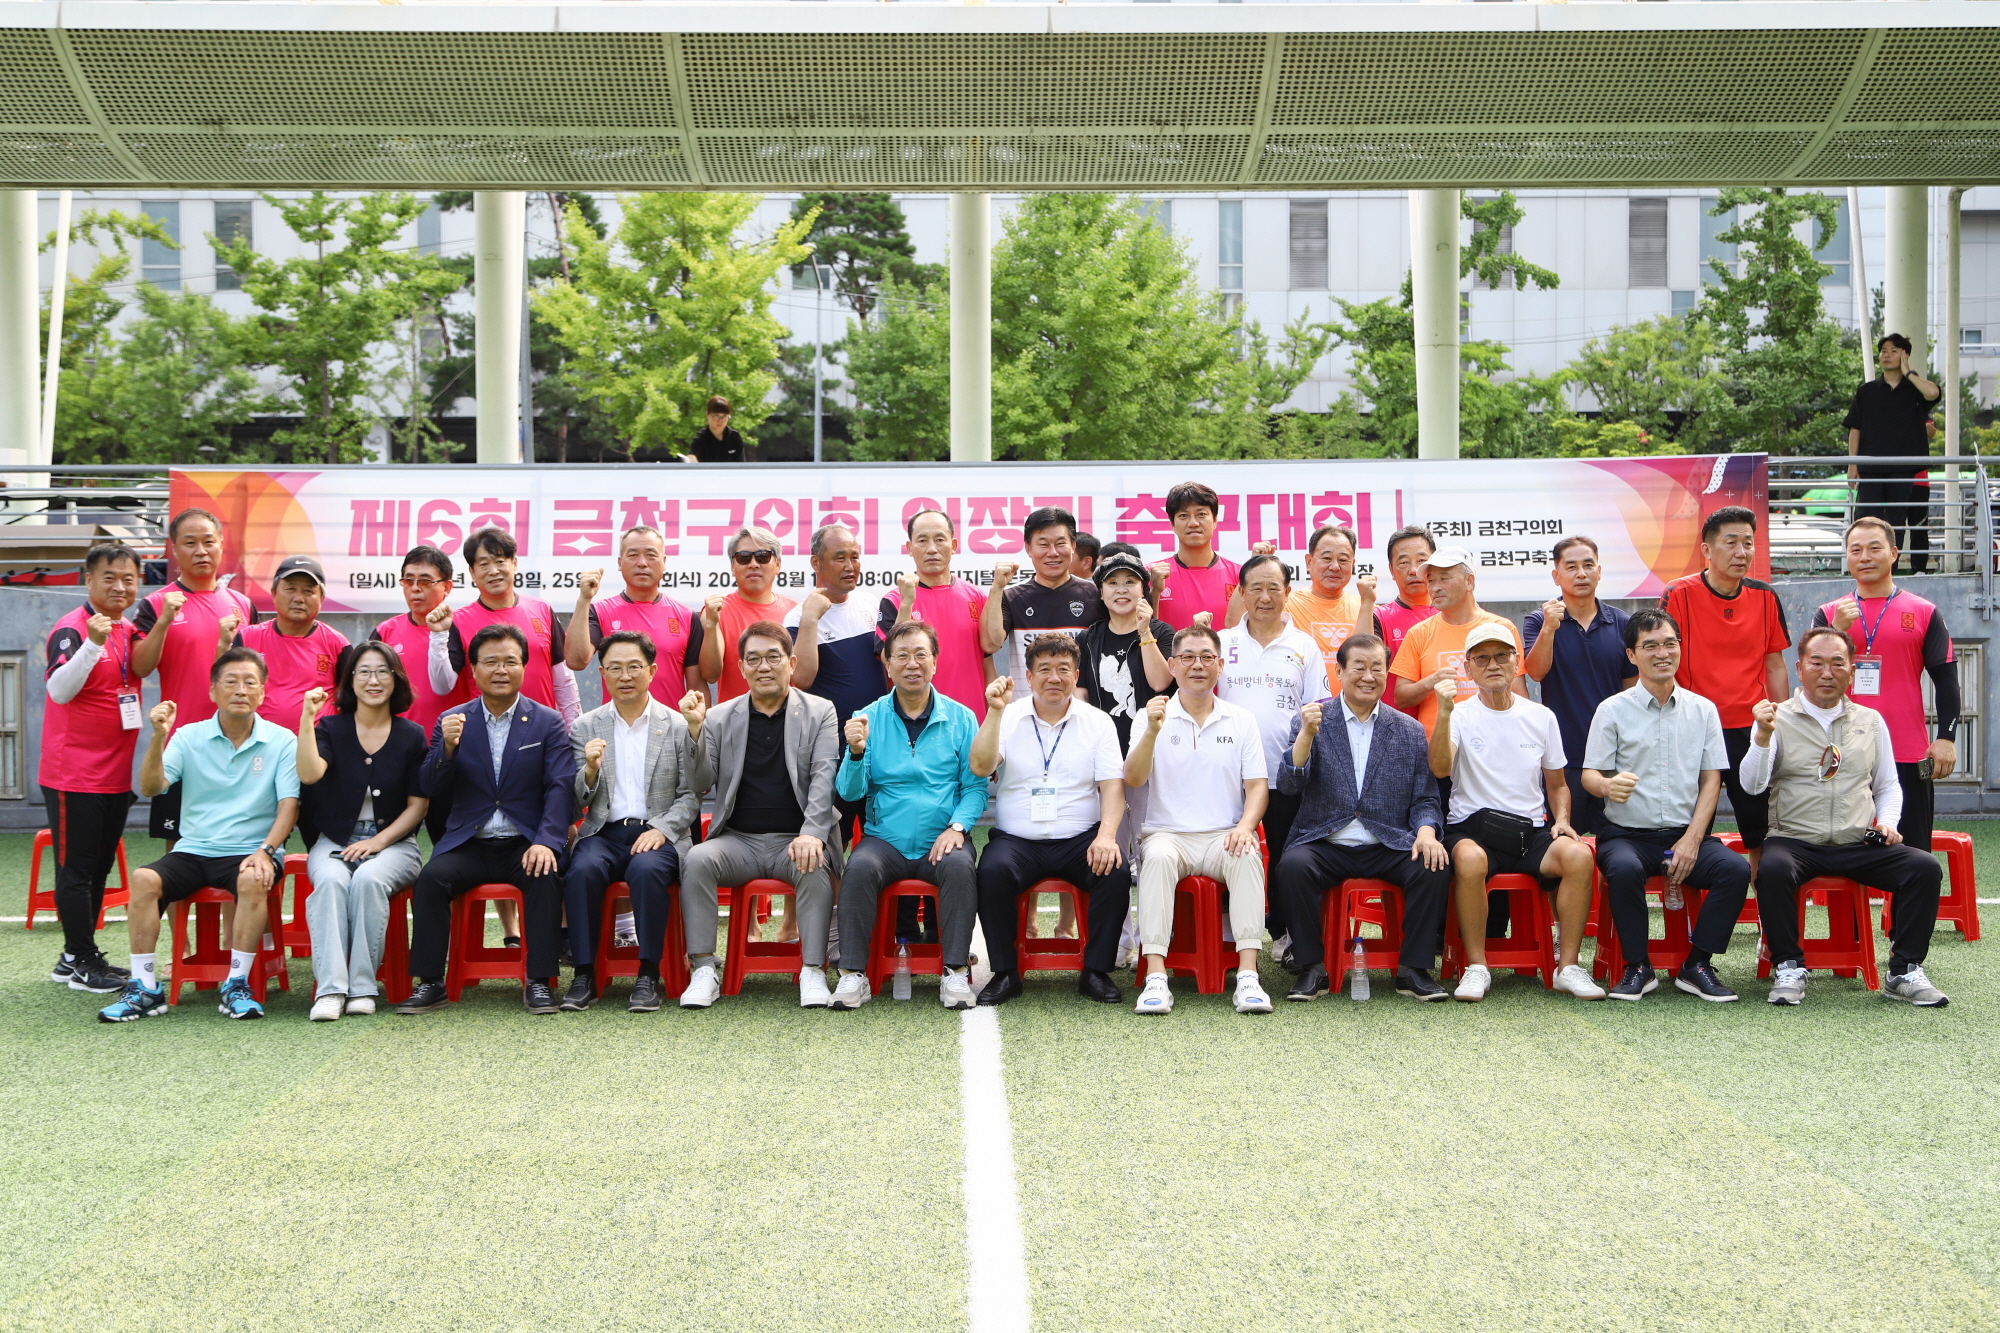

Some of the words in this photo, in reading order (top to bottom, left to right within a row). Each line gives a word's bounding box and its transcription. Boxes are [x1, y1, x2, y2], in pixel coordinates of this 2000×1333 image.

[348, 498, 530, 557] 제6회
[1478, 519, 1563, 537] 금천구의회
[513, 572, 547, 590] 8일,
[776, 571, 805, 588] 8월
[1228, 646, 1239, 664] 5
[1275, 694, 1296, 711] 금천
[1216, 735, 1234, 744] KFA
